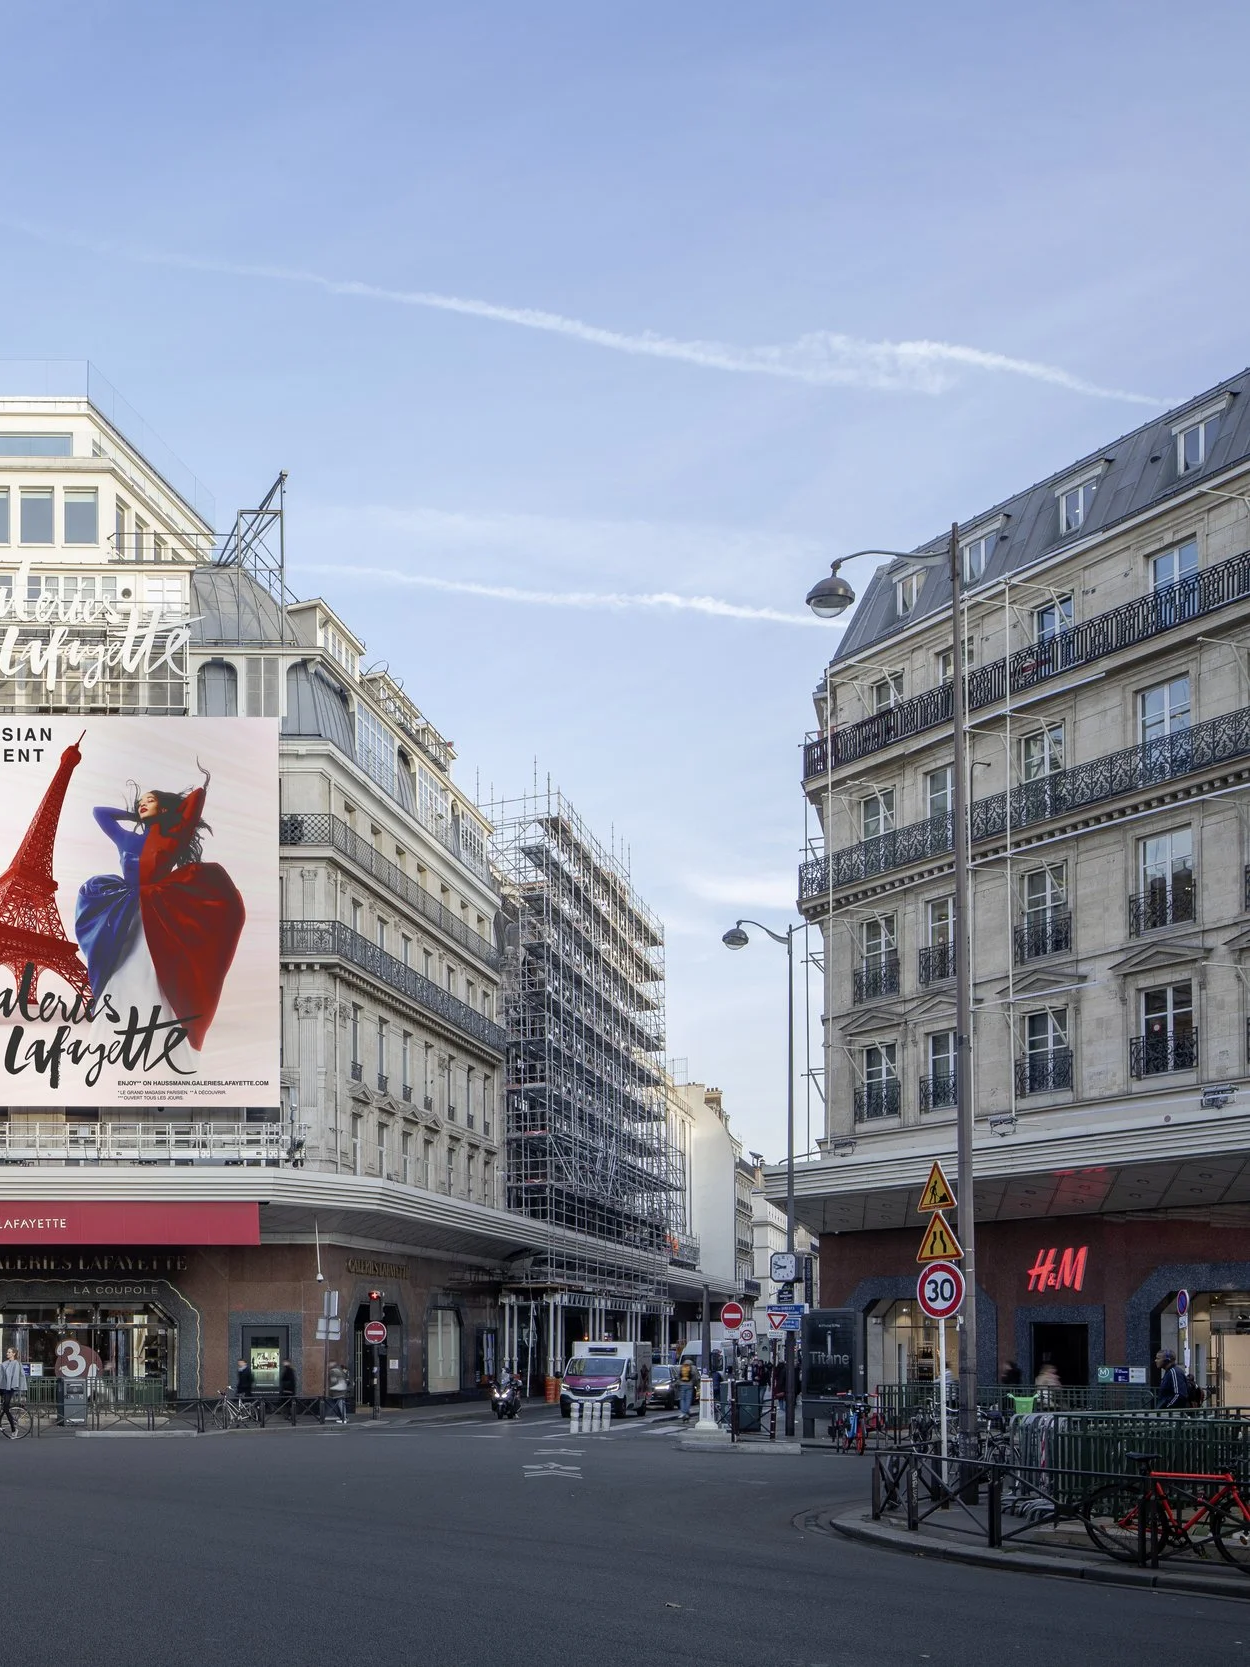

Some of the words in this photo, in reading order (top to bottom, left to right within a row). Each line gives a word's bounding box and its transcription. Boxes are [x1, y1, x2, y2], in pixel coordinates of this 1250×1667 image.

[0, 607, 206, 691] Lafayette
[4, 1005, 203, 1089] Lafayette
[78, 1255, 188, 1271] LAFAYETTE
[1027, 1246, 1089, 1293] H&M
[73, 1286, 90, 1295] LA
[95, 1286, 159, 1295] COUPOLE
[927, 1278, 955, 1303] 30
[57, 1340, 86, 1377] 3
[809, 1351, 850, 1365] Titane
